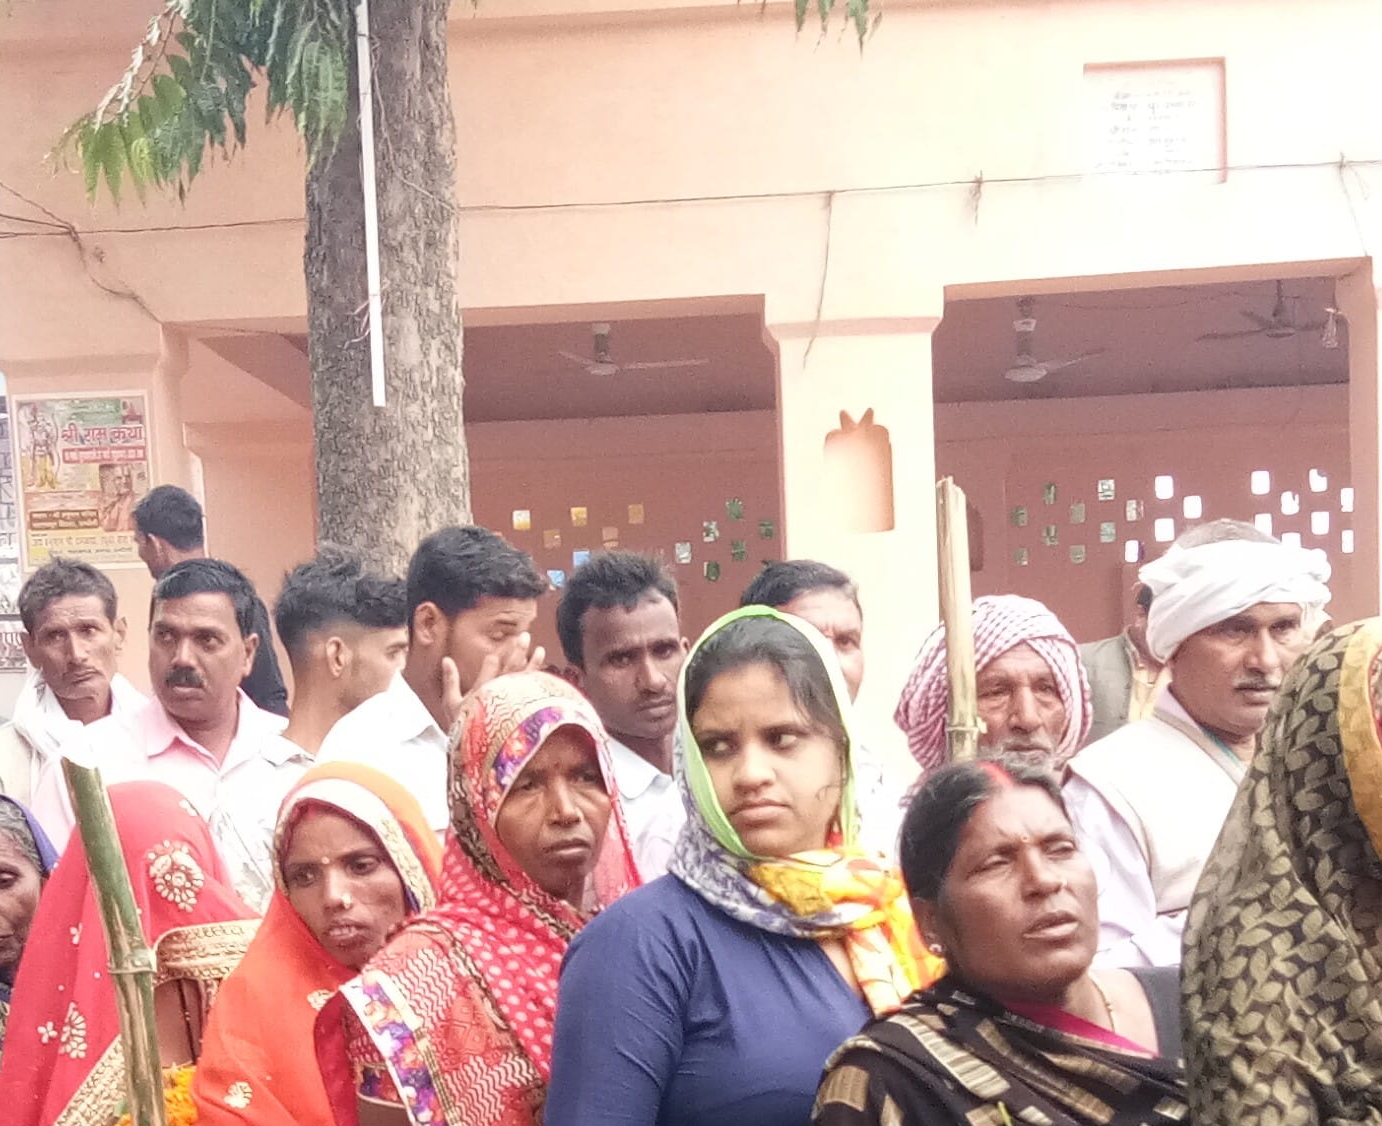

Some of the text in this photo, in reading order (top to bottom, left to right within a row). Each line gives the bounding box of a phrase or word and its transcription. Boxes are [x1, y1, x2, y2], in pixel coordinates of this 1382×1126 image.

[61, 422, 143, 442] श्री राम कथा
